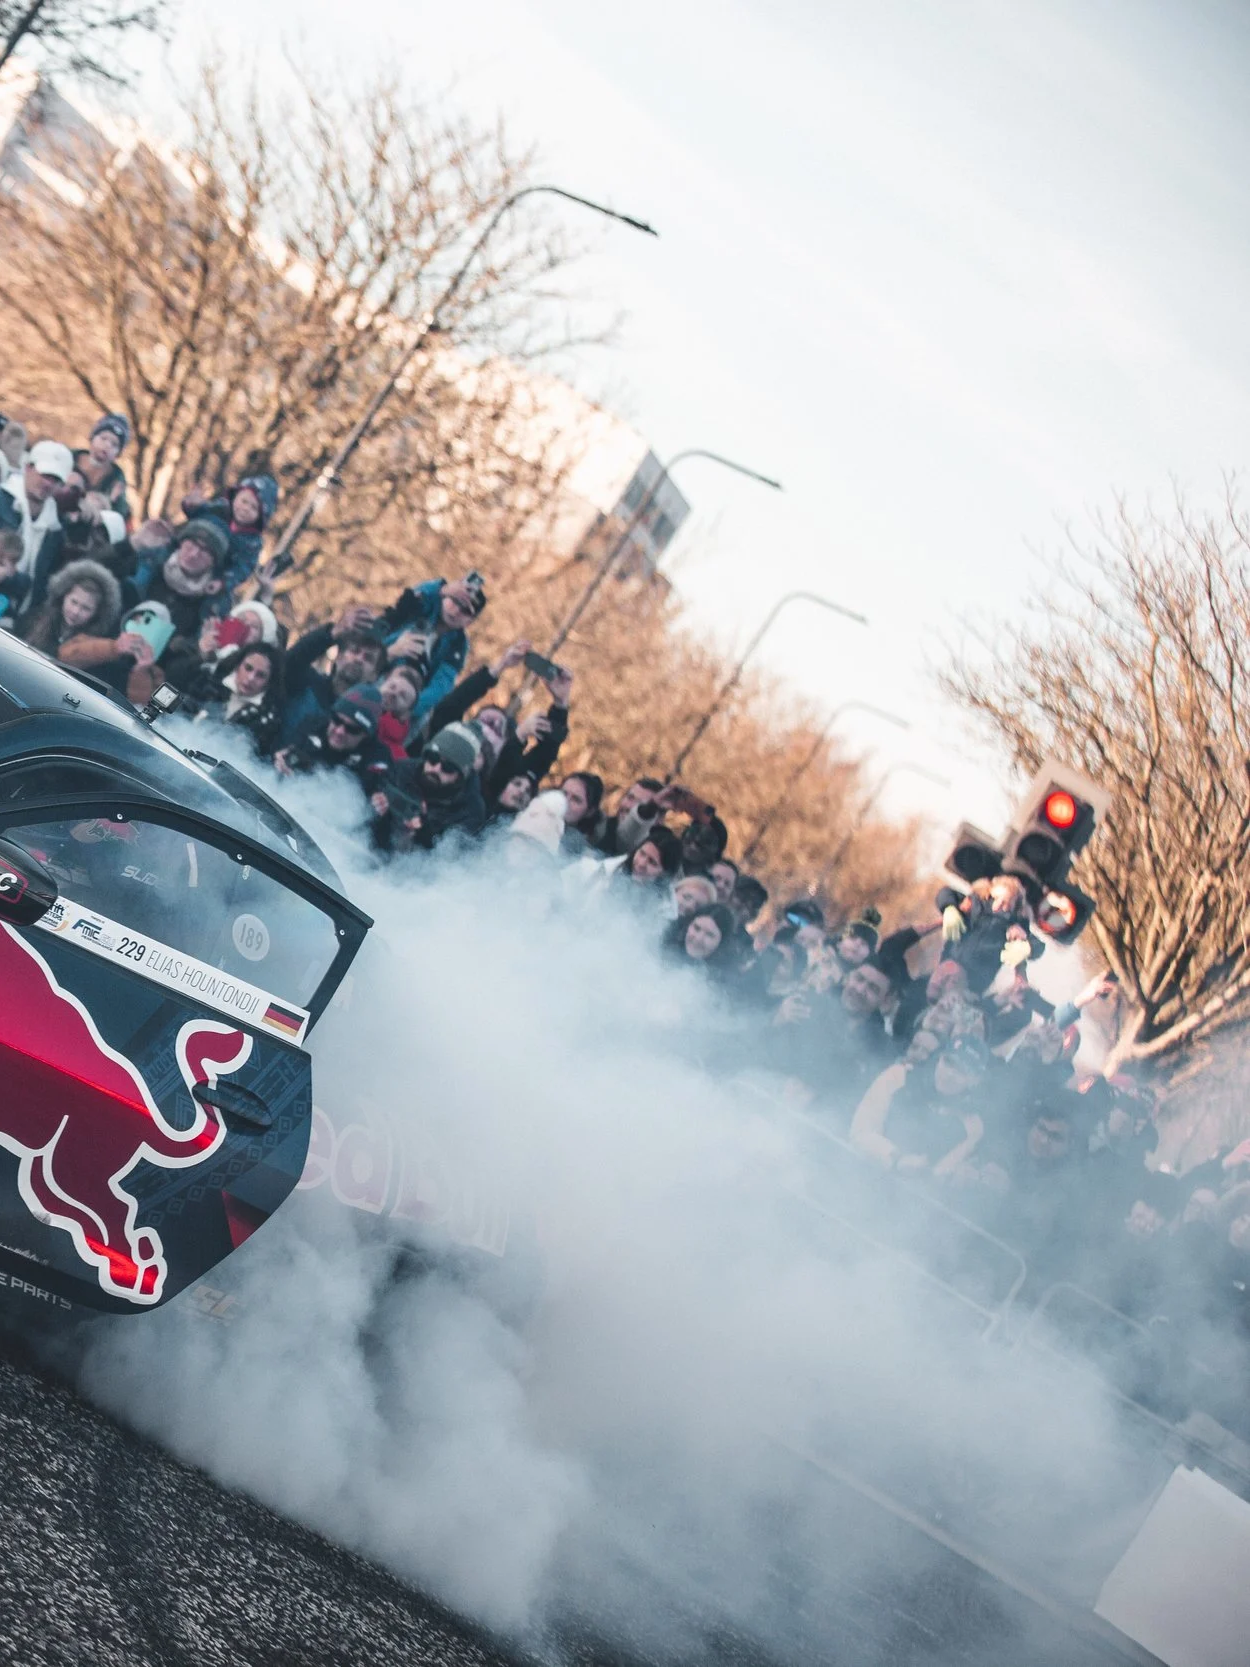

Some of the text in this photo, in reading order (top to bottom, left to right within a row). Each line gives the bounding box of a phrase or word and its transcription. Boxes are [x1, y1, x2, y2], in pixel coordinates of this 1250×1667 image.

[116, 937, 146, 961] 229
[145, 949, 183, 979] ELIAS
[180, 966, 260, 1014] HOUNTONDJI
[10, 1275, 72, 1311] PARTS
